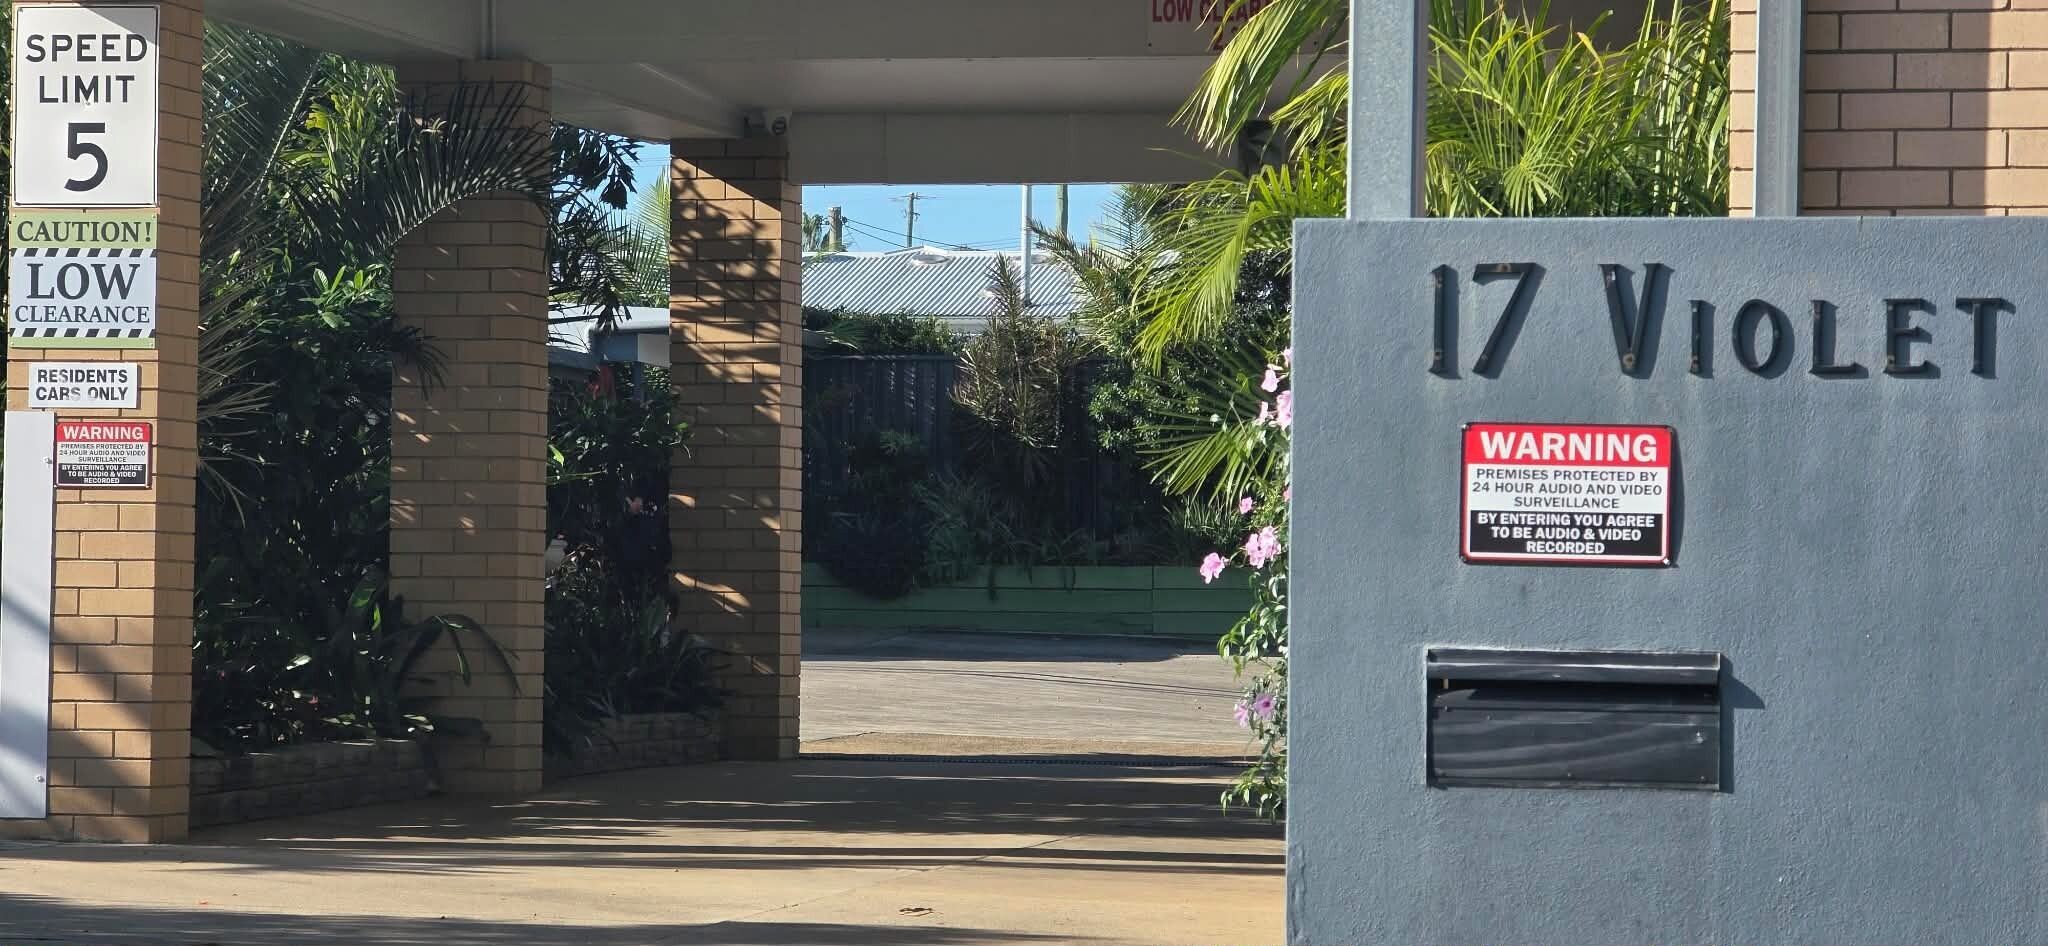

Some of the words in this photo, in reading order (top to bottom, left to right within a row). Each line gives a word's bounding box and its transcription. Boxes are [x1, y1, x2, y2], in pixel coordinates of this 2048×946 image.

[1151, 0, 1193, 23] LOW
[25, 34, 148, 63] SPEED
[39, 75, 135, 103] LIMIT
[63, 122, 108, 192] 5
[17, 220, 152, 242] CAUTION!
[26, 262, 141, 300] LOW
[15, 305, 150, 323] CLEARANCE
[1430, 262, 1545, 377] 17
[1597, 262, 2013, 378] VIOLET
[37, 369, 128, 384] RESIDENTS
[35, 386, 81, 401] CARS
[87, 386, 129, 401] ONLY
[63, 426, 144, 440] WARNING
[1480, 431, 1657, 462] WARNING
[1476, 468, 1549, 480] PREMISES
[1553, 470, 1636, 482] PROTECTED
[1640, 472, 1658, 482] BY
[1472, 482, 1490, 493] 24
[1495, 482, 1534, 493] HOUR
[1538, 483, 1582, 494] AUDIO
[1586, 484, 1616, 495] AND
[1620, 484, 1662, 496] VIDEO
[1514, 497, 1620, 509] SURVEILLANCE
[1478, 513, 1496, 525] BY
[1500, 513, 1570, 526] ENTERING
[1573, 514, 1602, 526] YOU
[1606, 515, 1655, 528] AGREE
[1490, 526, 1509, 538] TO
[1512, 527, 1532, 539] BE
[1535, 527, 1580, 539] AUDIO
[1583, 528, 1595, 540] &
[1598, 528, 1642, 541] VIDEO
[1526, 541, 1605, 554] RECORDED
